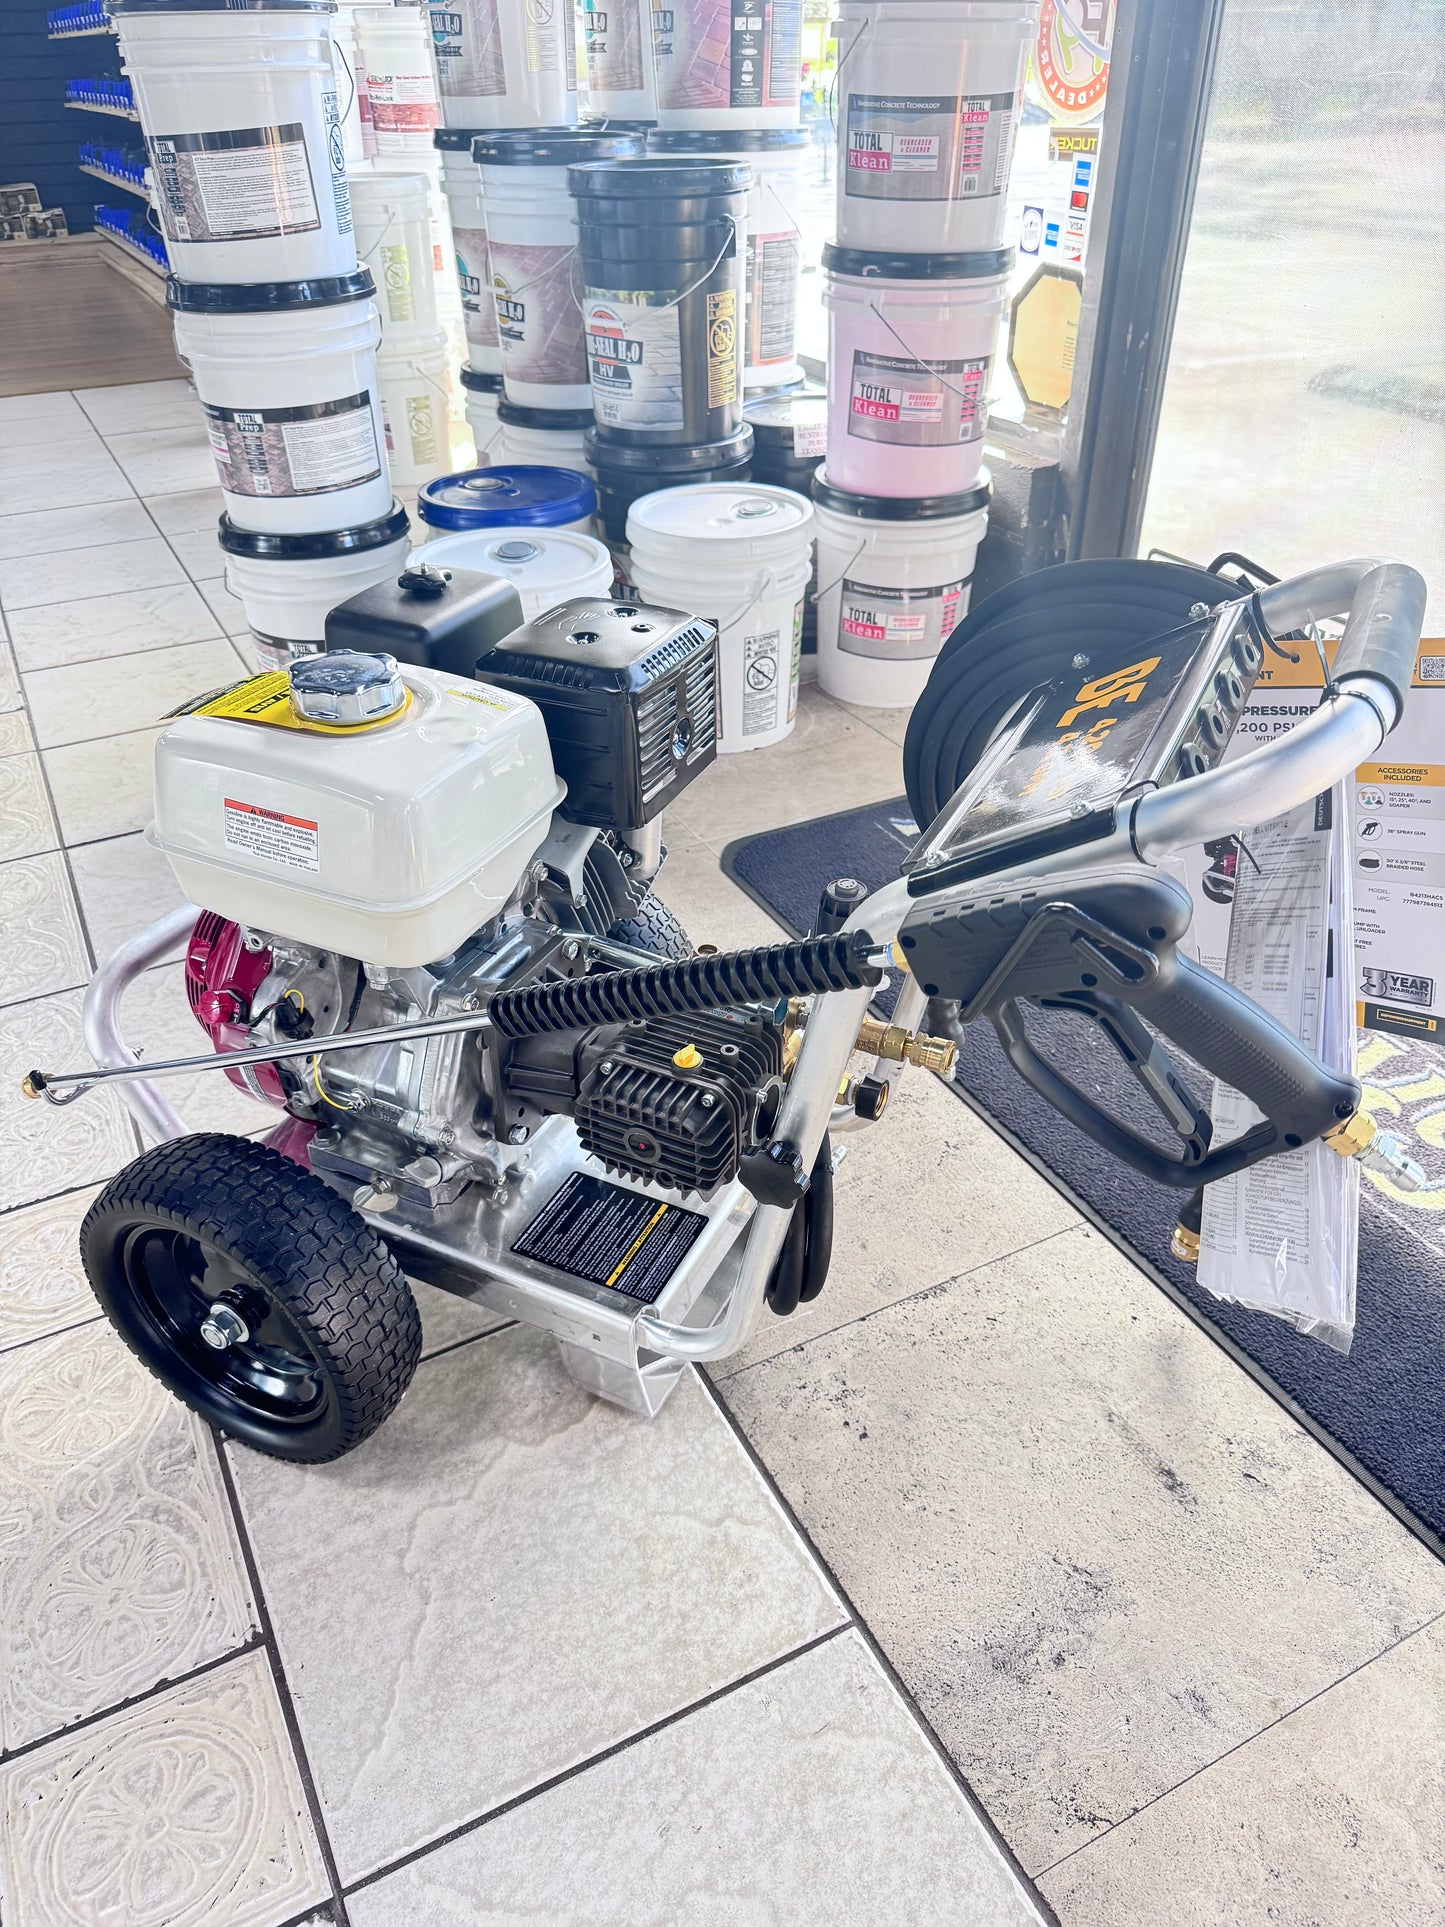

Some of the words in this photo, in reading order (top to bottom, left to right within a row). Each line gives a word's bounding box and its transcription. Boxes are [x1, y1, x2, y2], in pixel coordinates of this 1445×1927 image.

[967, 102, 986, 112] TOTAL
[963, 112, 989, 122] Klean
[854, 132, 883, 151] TOTAL
[158, 154, 174, 164] Prep
[850, 152, 888, 169] Klean
[599, 362, 614, 378] HV
[860, 384, 892, 403] TOTAL
[854, 400, 897, 419] Klean
[238, 414, 258, 424] TOTAL
[239, 424, 260, 433] Prep
[849, 608, 878, 625] TOTAL
[842, 620, 883, 639] Klean
[1056, 656, 1162, 728] BE
[1236, 722, 1268, 734] ,200
[258, 808, 284, 822] WARNING
[1360, 967, 1387, 997] 3
[1390, 975, 1429, 992] YEAR
[1390, 986, 1430, 998] WARRANTY
[621, 1245, 638, 1266] WARNING
